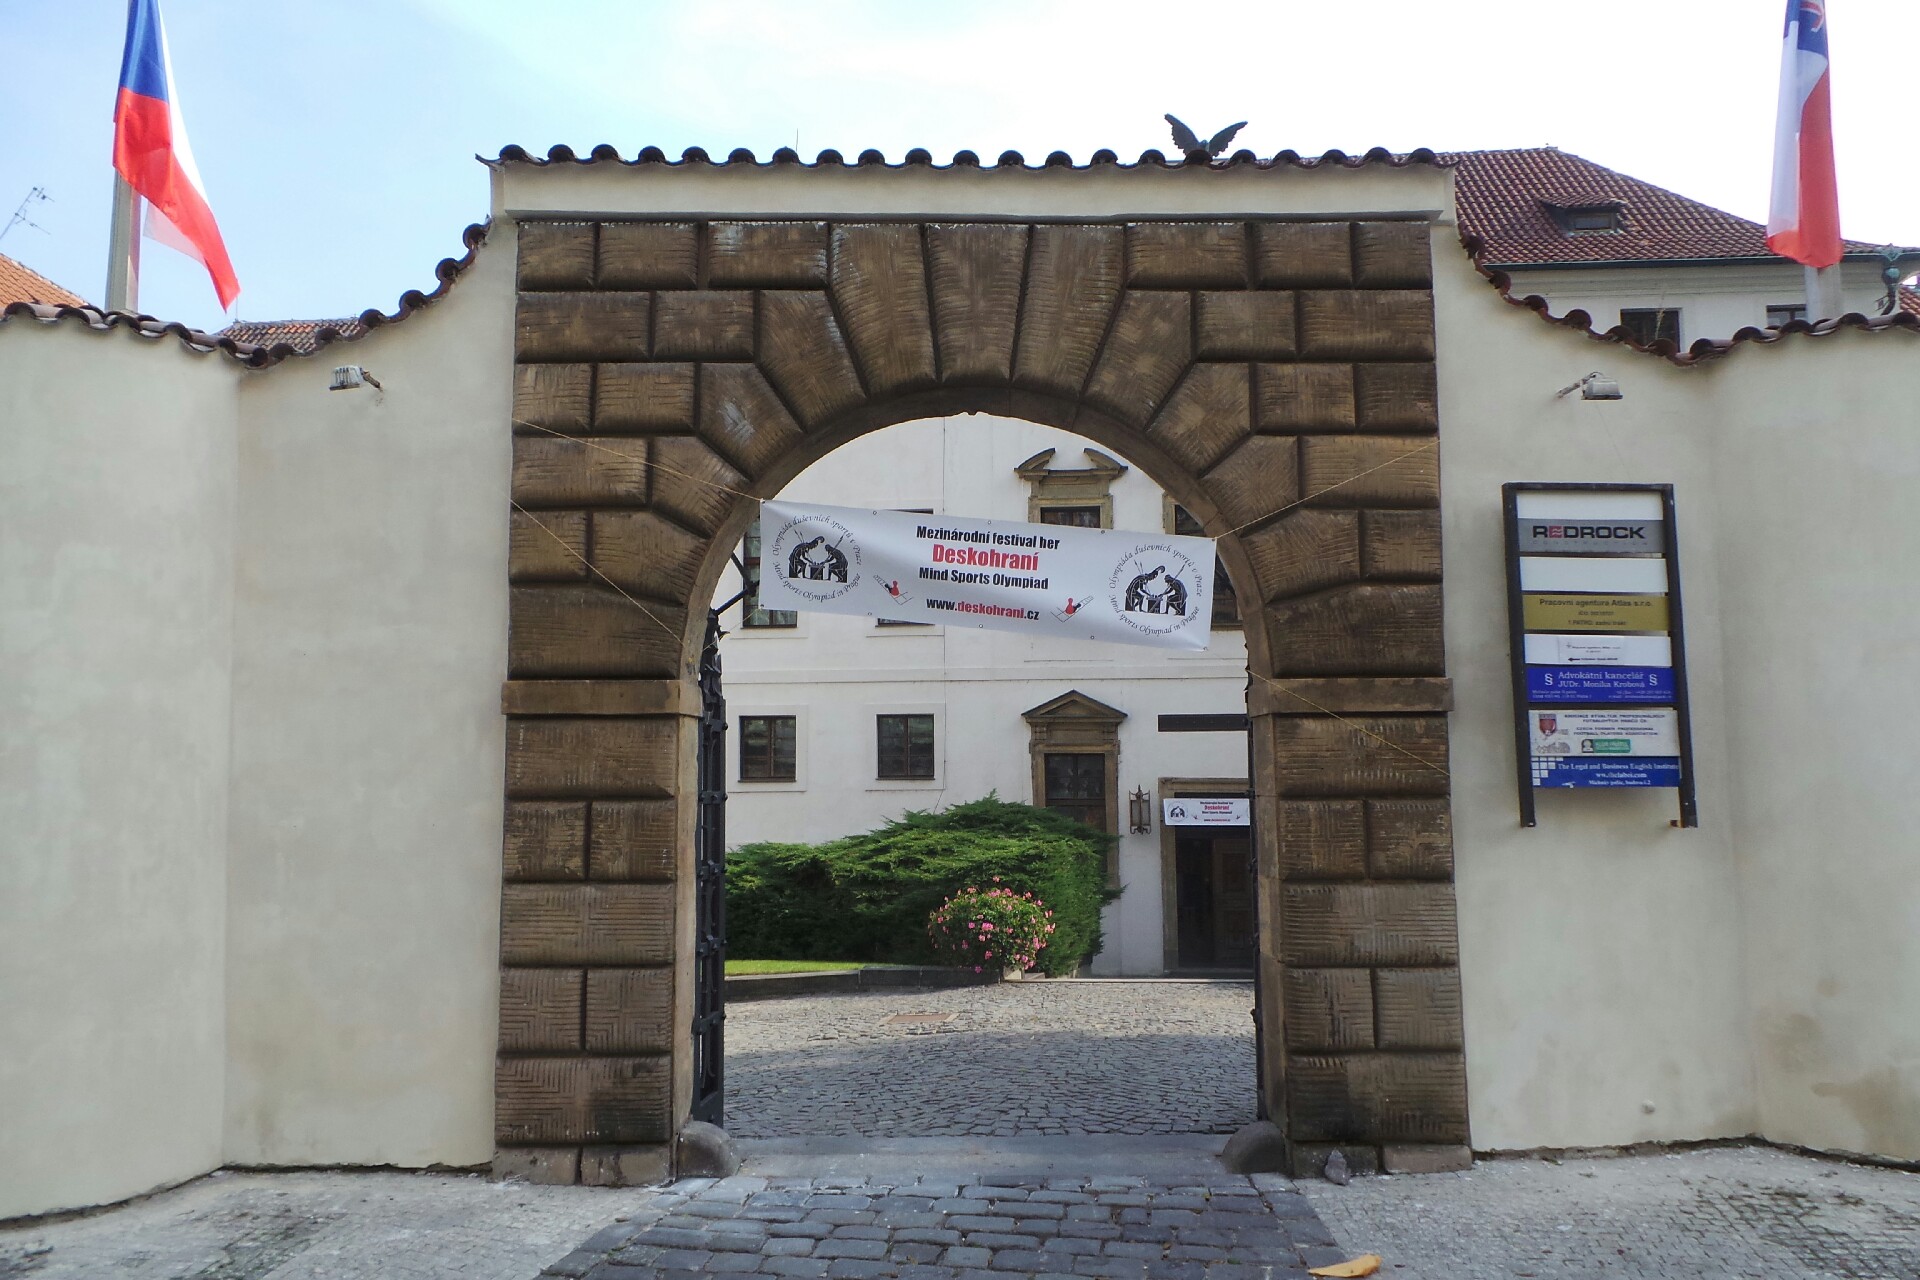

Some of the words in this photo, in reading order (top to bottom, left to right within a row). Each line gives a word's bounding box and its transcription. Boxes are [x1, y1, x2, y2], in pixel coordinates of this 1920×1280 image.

[916, 525, 991, 544] Mezinárodní
[992, 531, 1037, 549] festival
[1038, 536, 1061, 550] her
[1532, 525, 1646, 539] REDROCK
[932, 543, 1040, 571] Deskohraní
[919, 567, 949, 581] Mind
[950, 569, 990, 585] Sports
[992, 573, 1049, 590] Olympiad
[926, 598, 1040, 621] www.deskohrani.cz
[1575, 599, 1609, 608] agentura
[1611, 599, 1632, 607] Atlas
[1558, 671, 1603, 680] Advokátní
[1604, 671, 1644, 680] kancelář
[1557, 680, 1581, 688] JUDr.
[1583, 680, 1611, 688] Monika
[1613, 680, 1646, 688] Krobová
[1570, 763, 1588, 771] Legal
[1630, 763, 1653, 771] English
